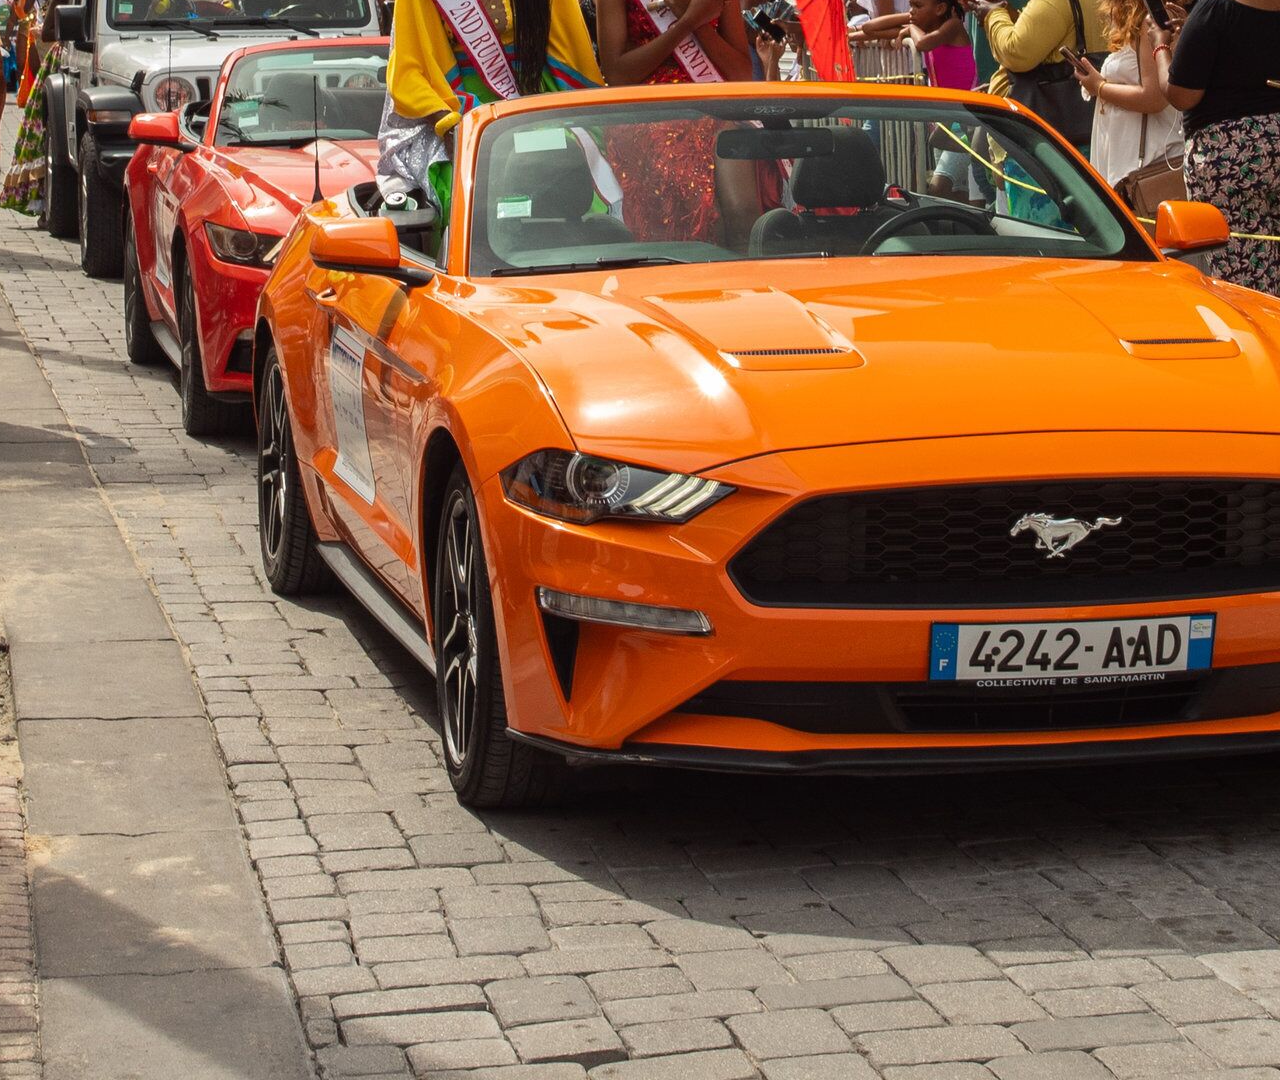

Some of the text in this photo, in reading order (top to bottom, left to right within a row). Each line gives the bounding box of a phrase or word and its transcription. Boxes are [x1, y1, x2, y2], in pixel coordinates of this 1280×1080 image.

[449, 0, 517, 97] 2ND RUNNER
[938, 659, 949, 672] F
[976, 672, 1166, 688] COLLECTIVITE DE SAINT-MARTIN
